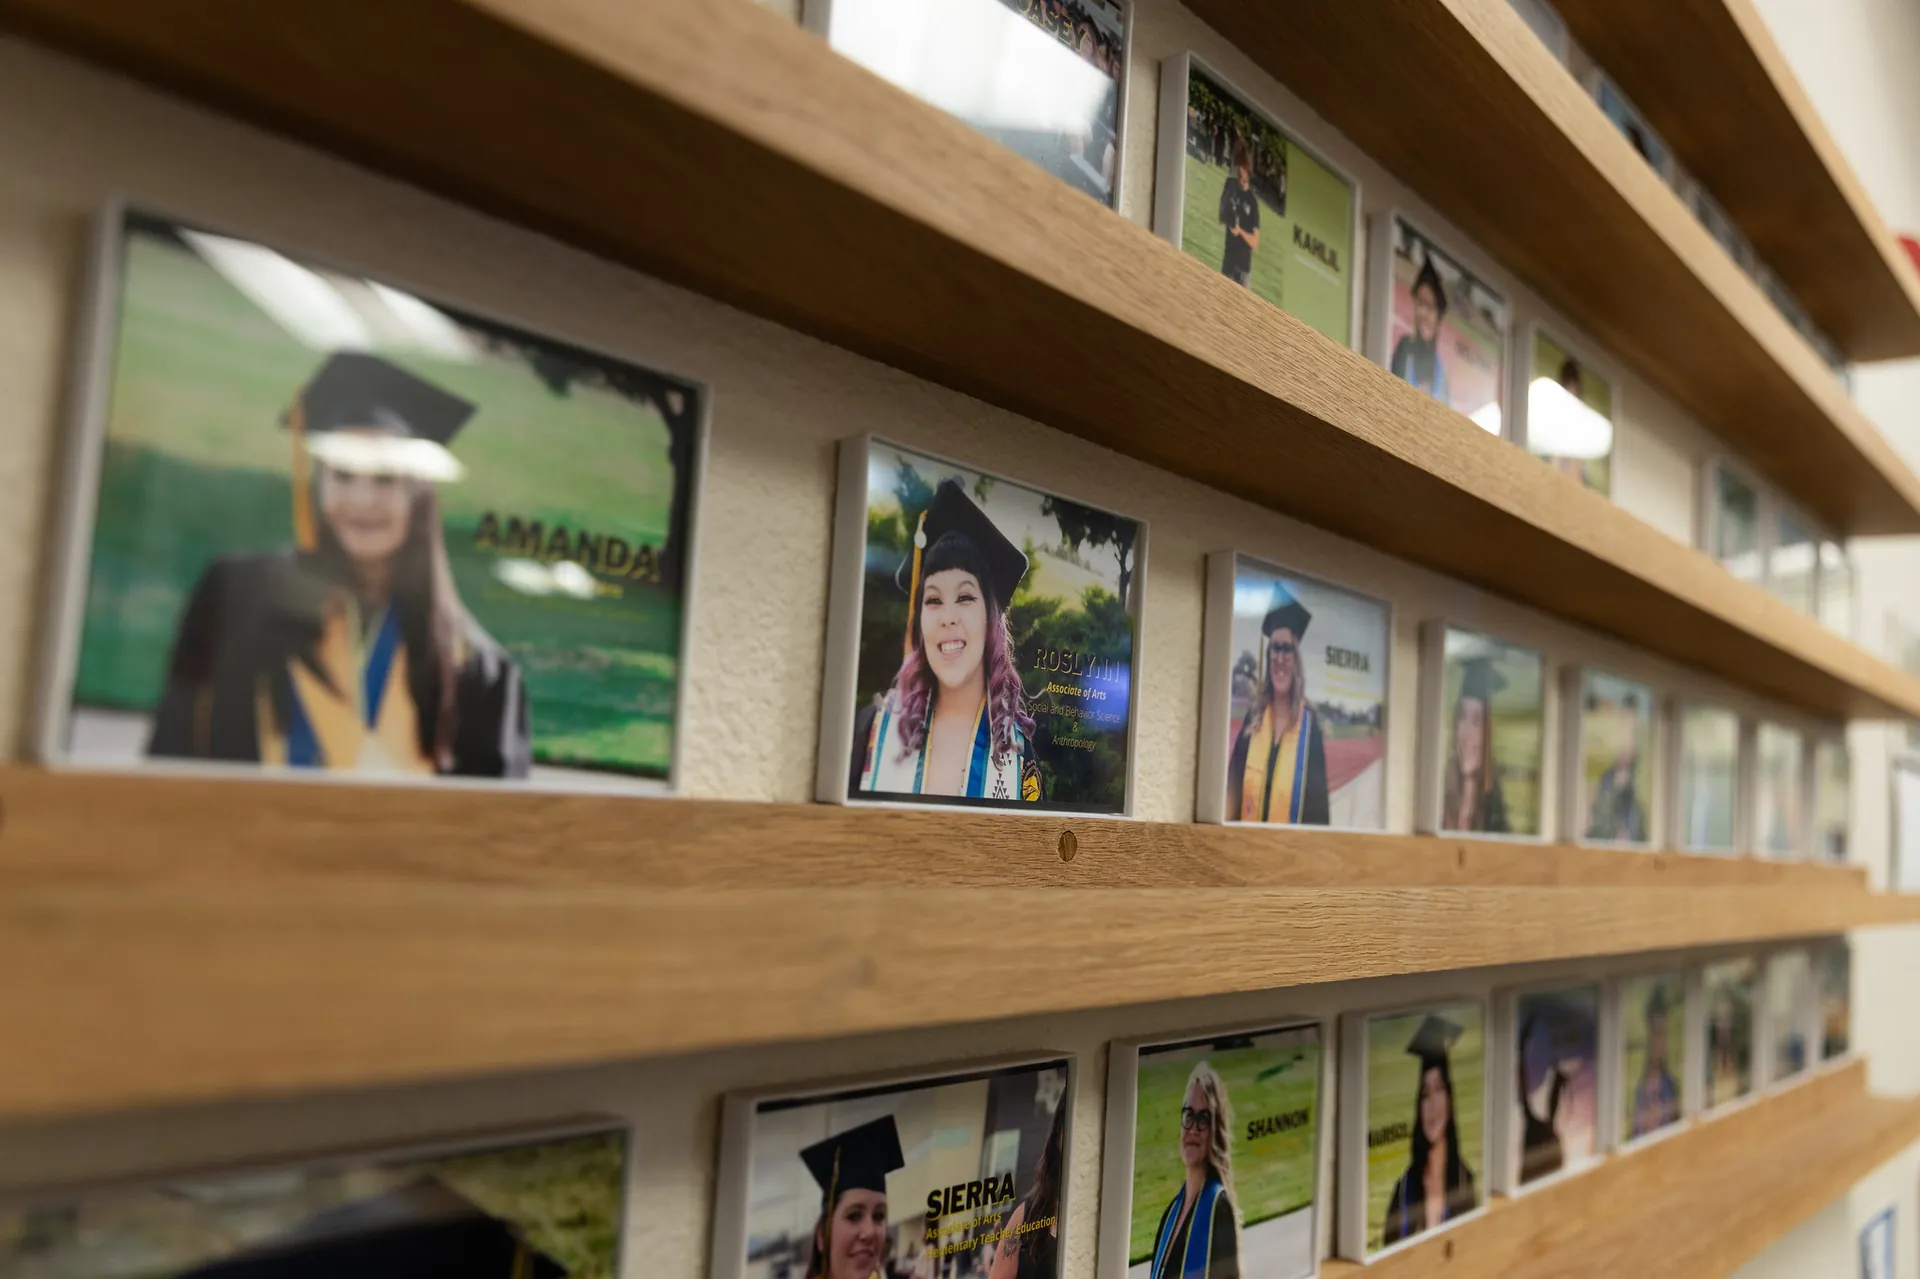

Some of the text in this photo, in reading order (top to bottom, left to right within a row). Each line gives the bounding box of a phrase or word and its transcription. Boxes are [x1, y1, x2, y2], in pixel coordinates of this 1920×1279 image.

[475, 510, 660, 582] AMANDA
[1325, 645, 1371, 673] SIERRA
[1047, 682, 1106, 700] Associate of Arts
[1027, 700, 1121, 723] Social and Behavior Science
[1072, 721, 1079, 732] &
[1052, 735, 1096, 751] Anthropology
[1247, 1109, 1308, 1141] SHANNON
[926, 1172, 1016, 1221] SIERRA
[972, 1214, 982, 1228] of
[983, 1211, 1002, 1225] Arts
[926, 1215, 1057, 1260] Elementary Teacher Education
